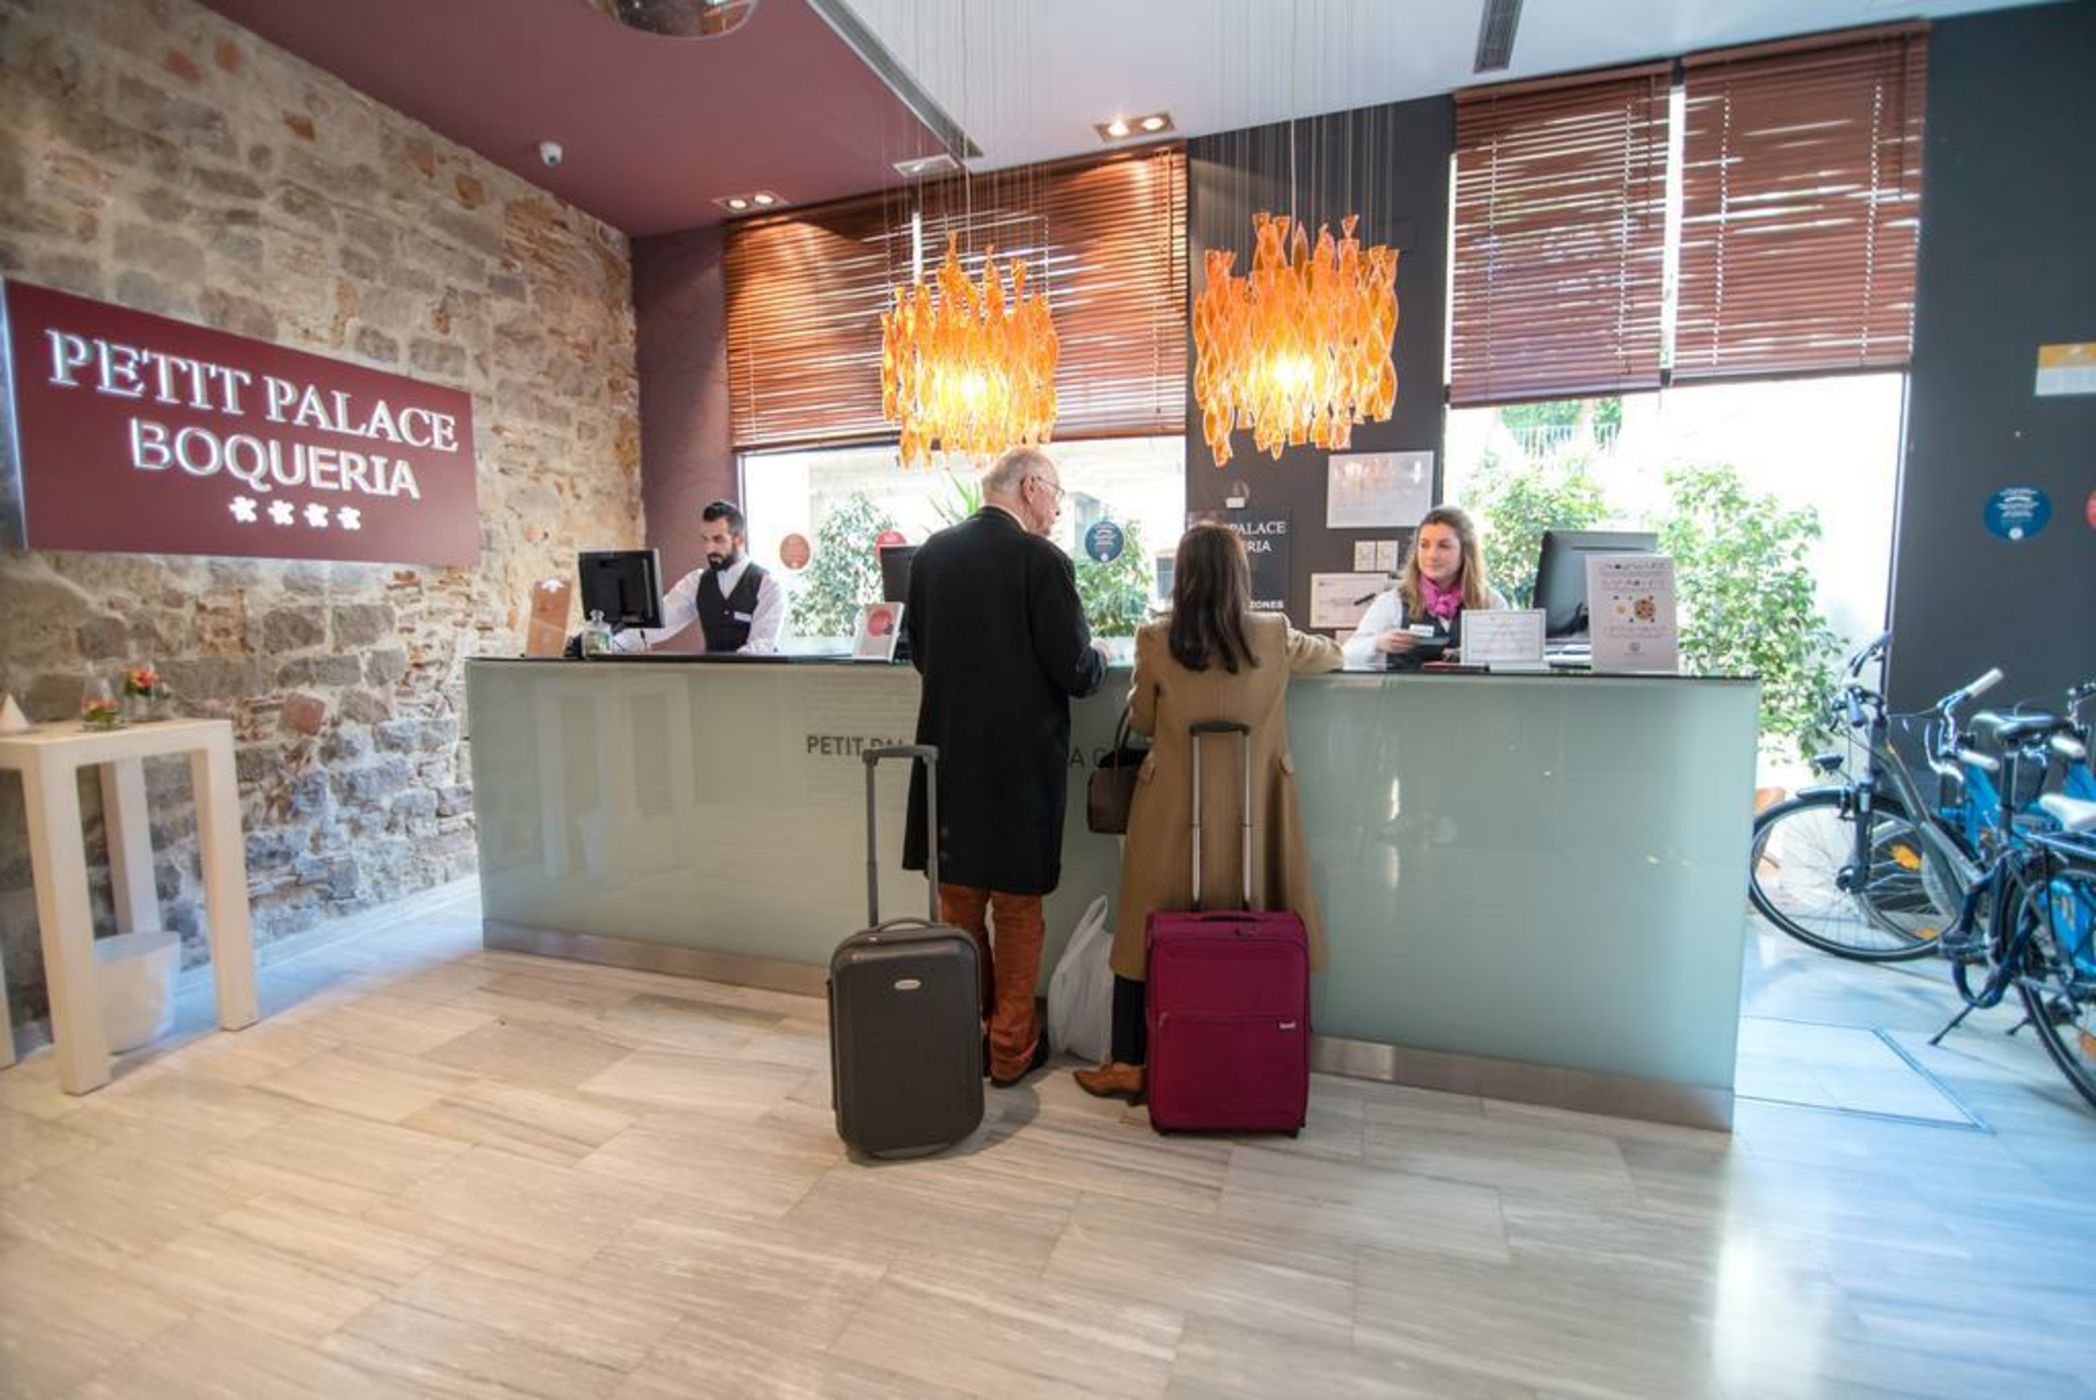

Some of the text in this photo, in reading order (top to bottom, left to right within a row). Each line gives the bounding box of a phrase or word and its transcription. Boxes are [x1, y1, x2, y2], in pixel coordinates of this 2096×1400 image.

[45, 328, 459, 453] PETIT PALACE
[130, 416, 421, 499] BOQUERIA
[806, 735, 864, 756] PETIT
